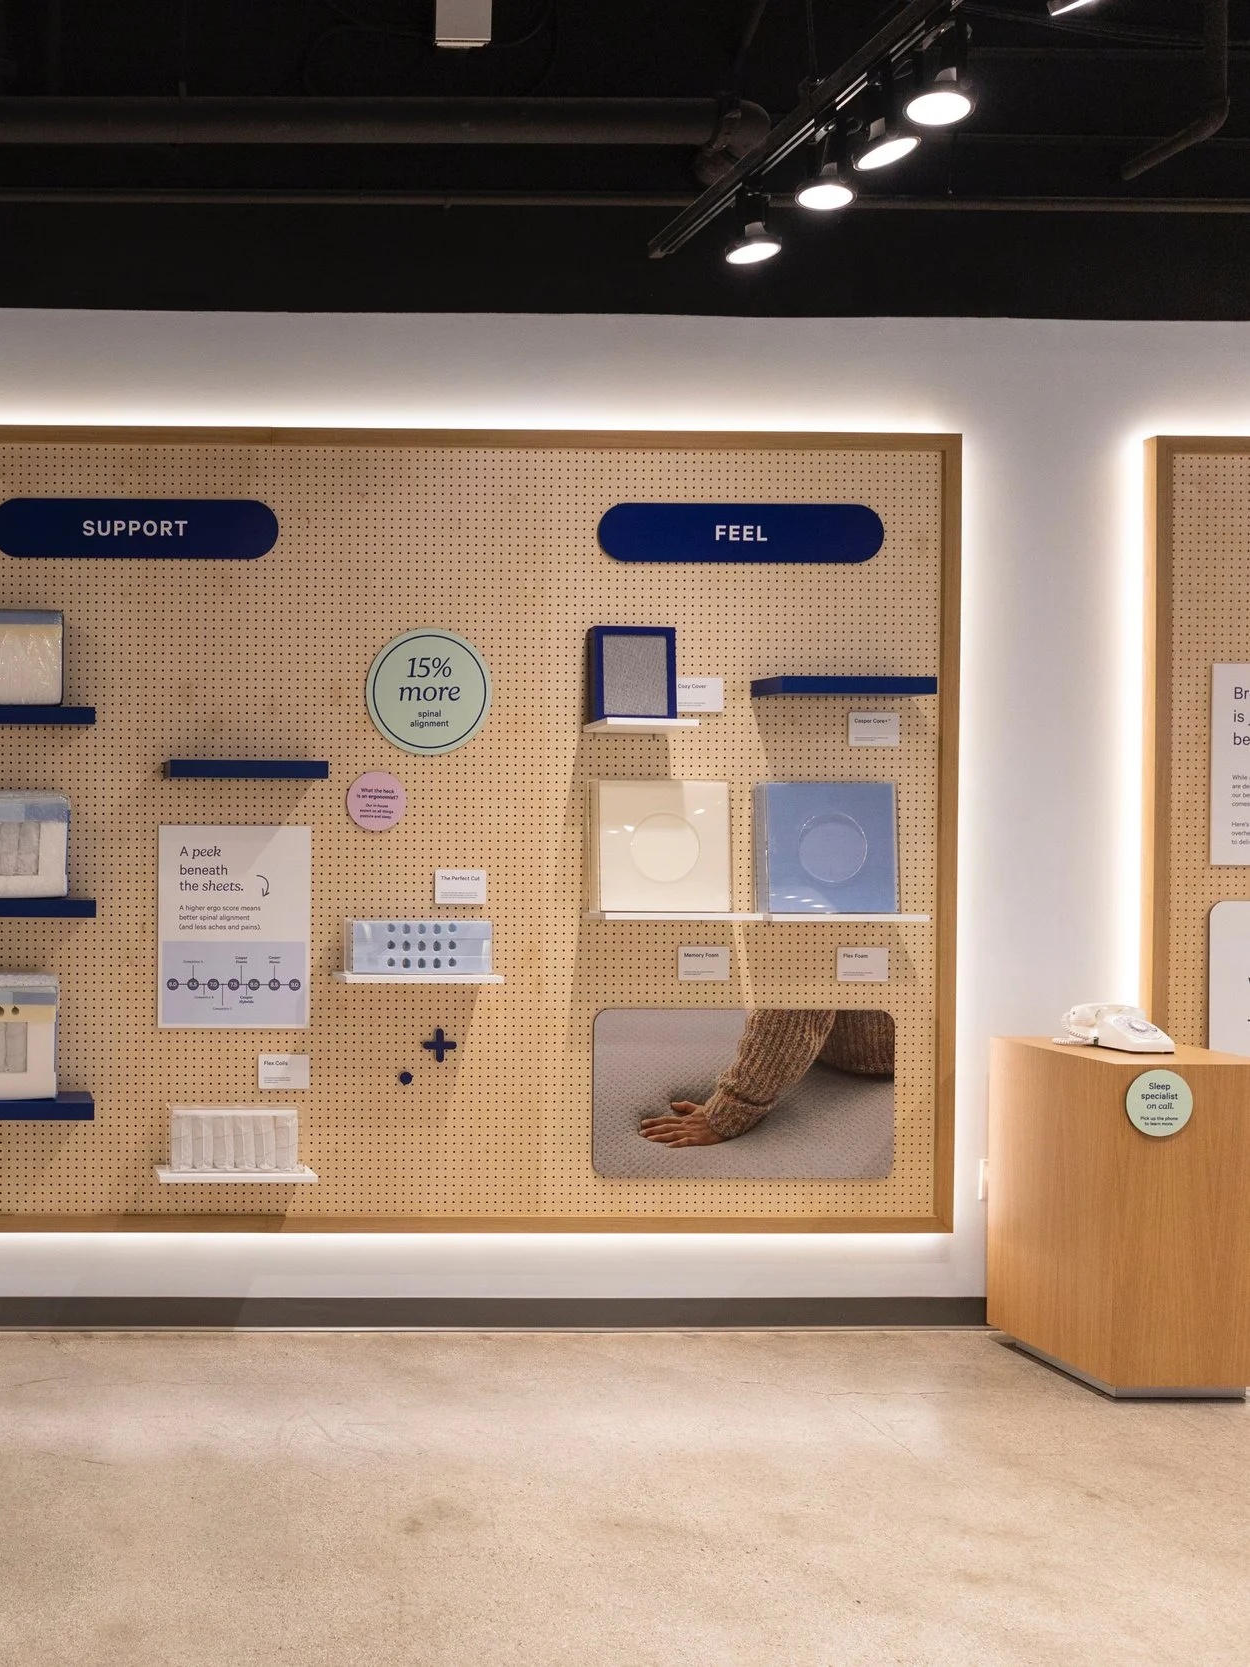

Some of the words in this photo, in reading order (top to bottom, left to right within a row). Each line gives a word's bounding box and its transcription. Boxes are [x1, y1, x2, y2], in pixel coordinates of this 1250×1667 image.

[82, 519, 188, 537] SUPPORT
[715, 524, 768, 542] FEEL
[406, 656, 452, 678] 15%
[398, 686, 461, 702] more
[417, 709, 442, 719] spinal
[1233, 709, 1245, 724] is
[409, 719, 449, 729] alignment
[179, 846, 189, 857] A
[191, 845, 222, 860] peek
[179, 863, 228, 876] beneath
[178, 879, 199, 892] the
[201, 879, 244, 892] sheets.
[185, 904, 206, 913] higher
[206, 905, 222, 913] ergo
[199, 914, 218, 922] spinal
[219, 914, 250, 922] alignment
[178, 923, 194, 931] (and
[1148, 1082, 1171, 1092] Sleep
[1140, 1092, 1178, 1101] specialist
[1158, 1102, 1175, 1110] call.
